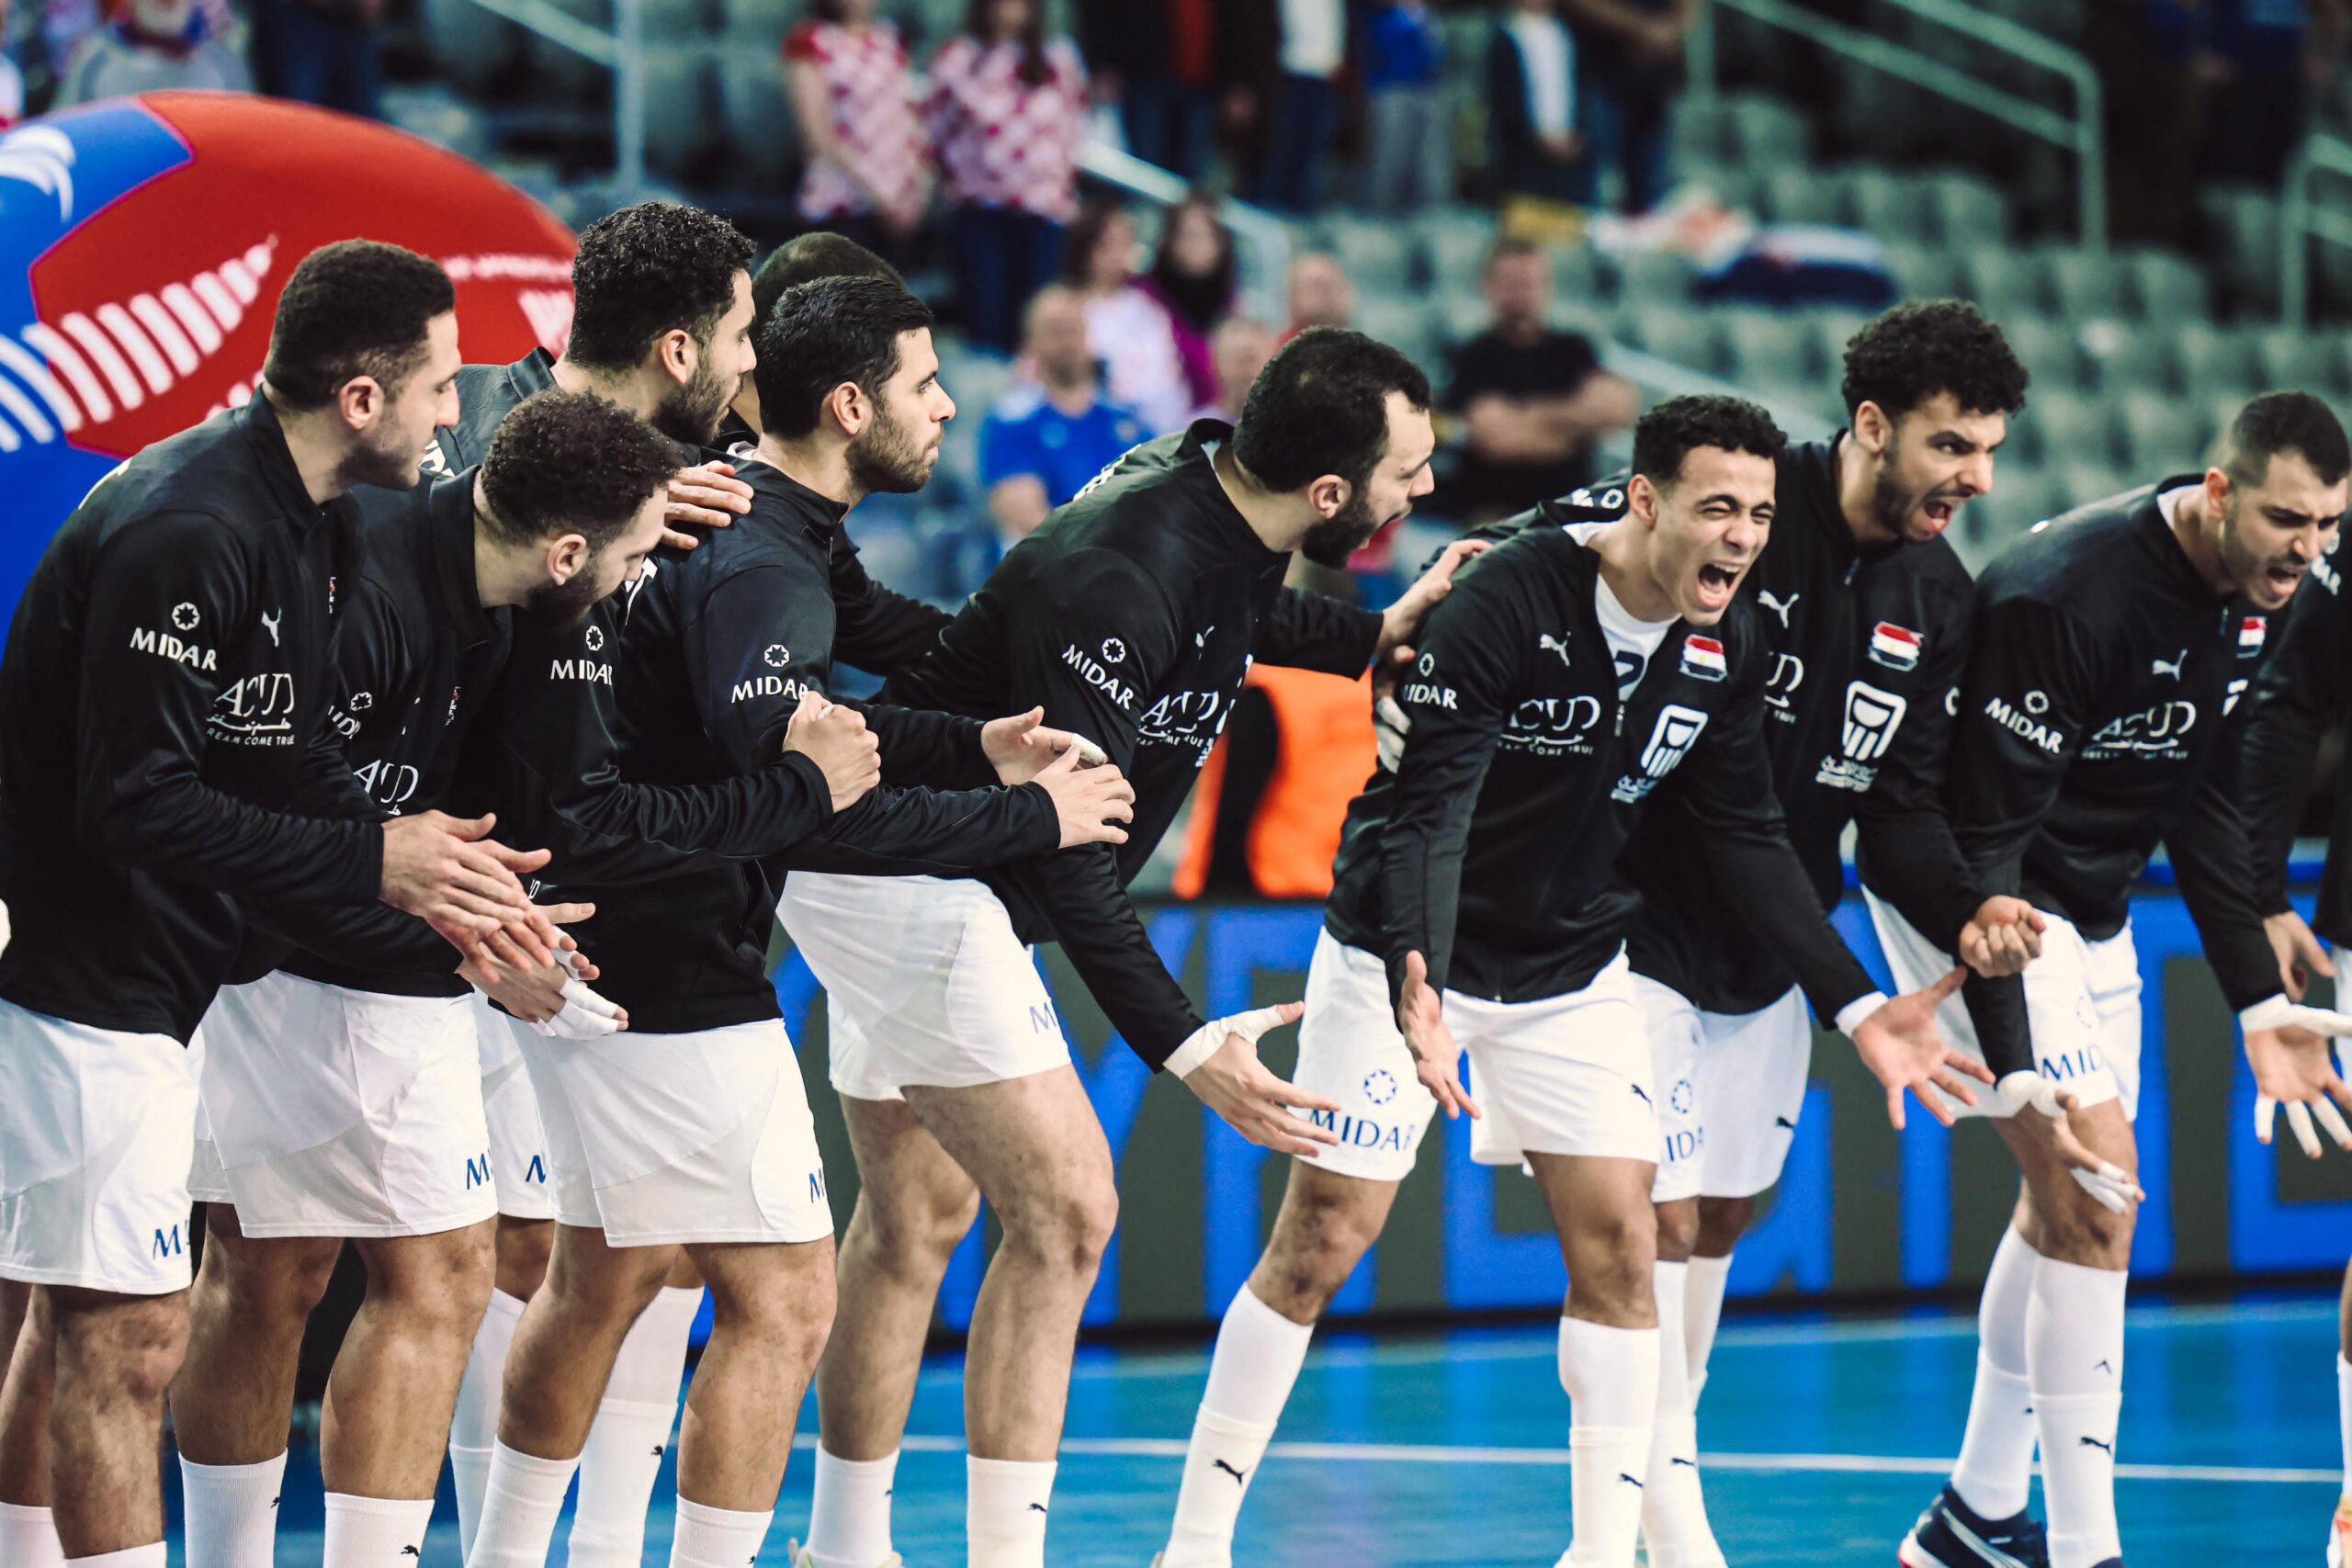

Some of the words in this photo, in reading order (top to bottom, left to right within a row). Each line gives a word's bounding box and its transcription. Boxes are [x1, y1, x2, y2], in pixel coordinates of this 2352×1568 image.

[130, 626, 217, 671] MIDAR
[1062, 644, 1135, 711] MIDAR
[1403, 683, 1458, 710] IDAR
[207, 728, 241, 744] REAM
[243, 736, 273, 747] COME
[1984, 697, 2064, 754] MIDAR
